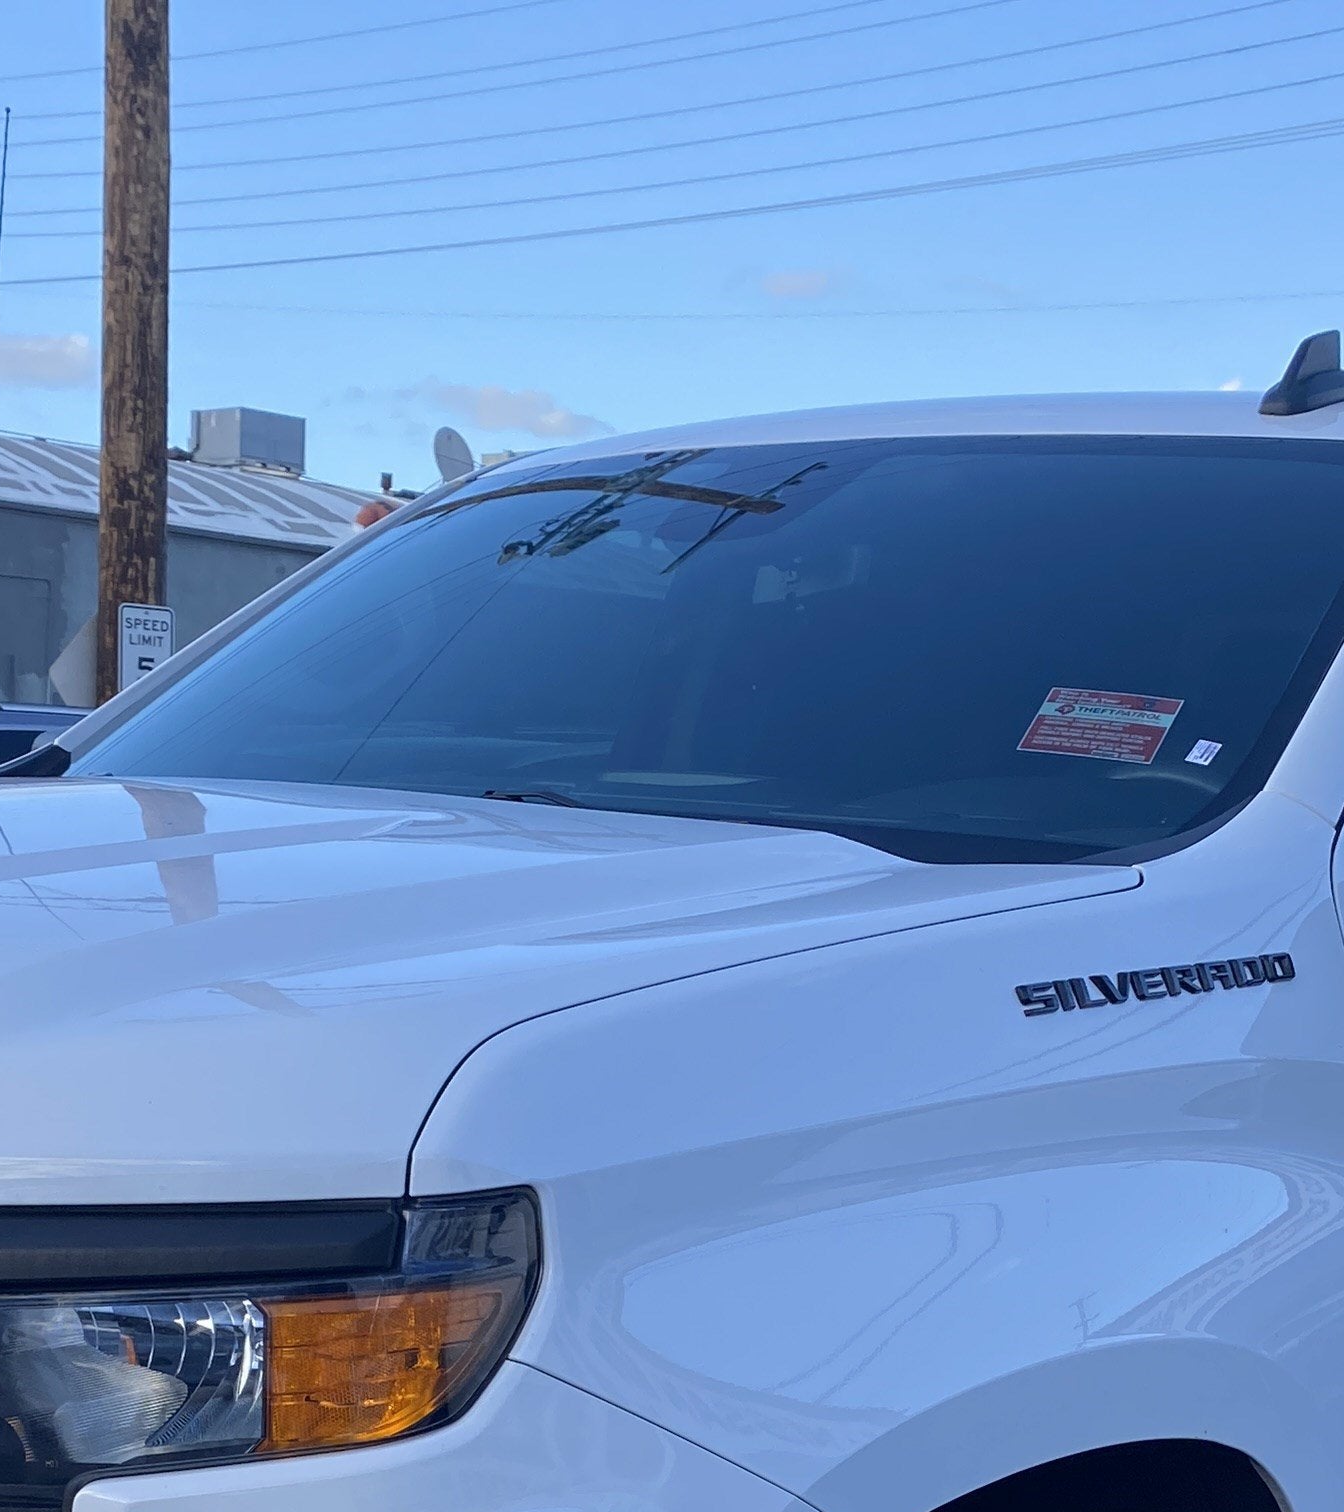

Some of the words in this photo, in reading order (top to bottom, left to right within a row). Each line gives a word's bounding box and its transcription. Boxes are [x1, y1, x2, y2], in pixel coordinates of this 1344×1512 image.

[125, 617, 169, 632] SPEED
[129, 634, 164, 647] LIMIT
[1015, 952, 1296, 1017] SILVERADO
